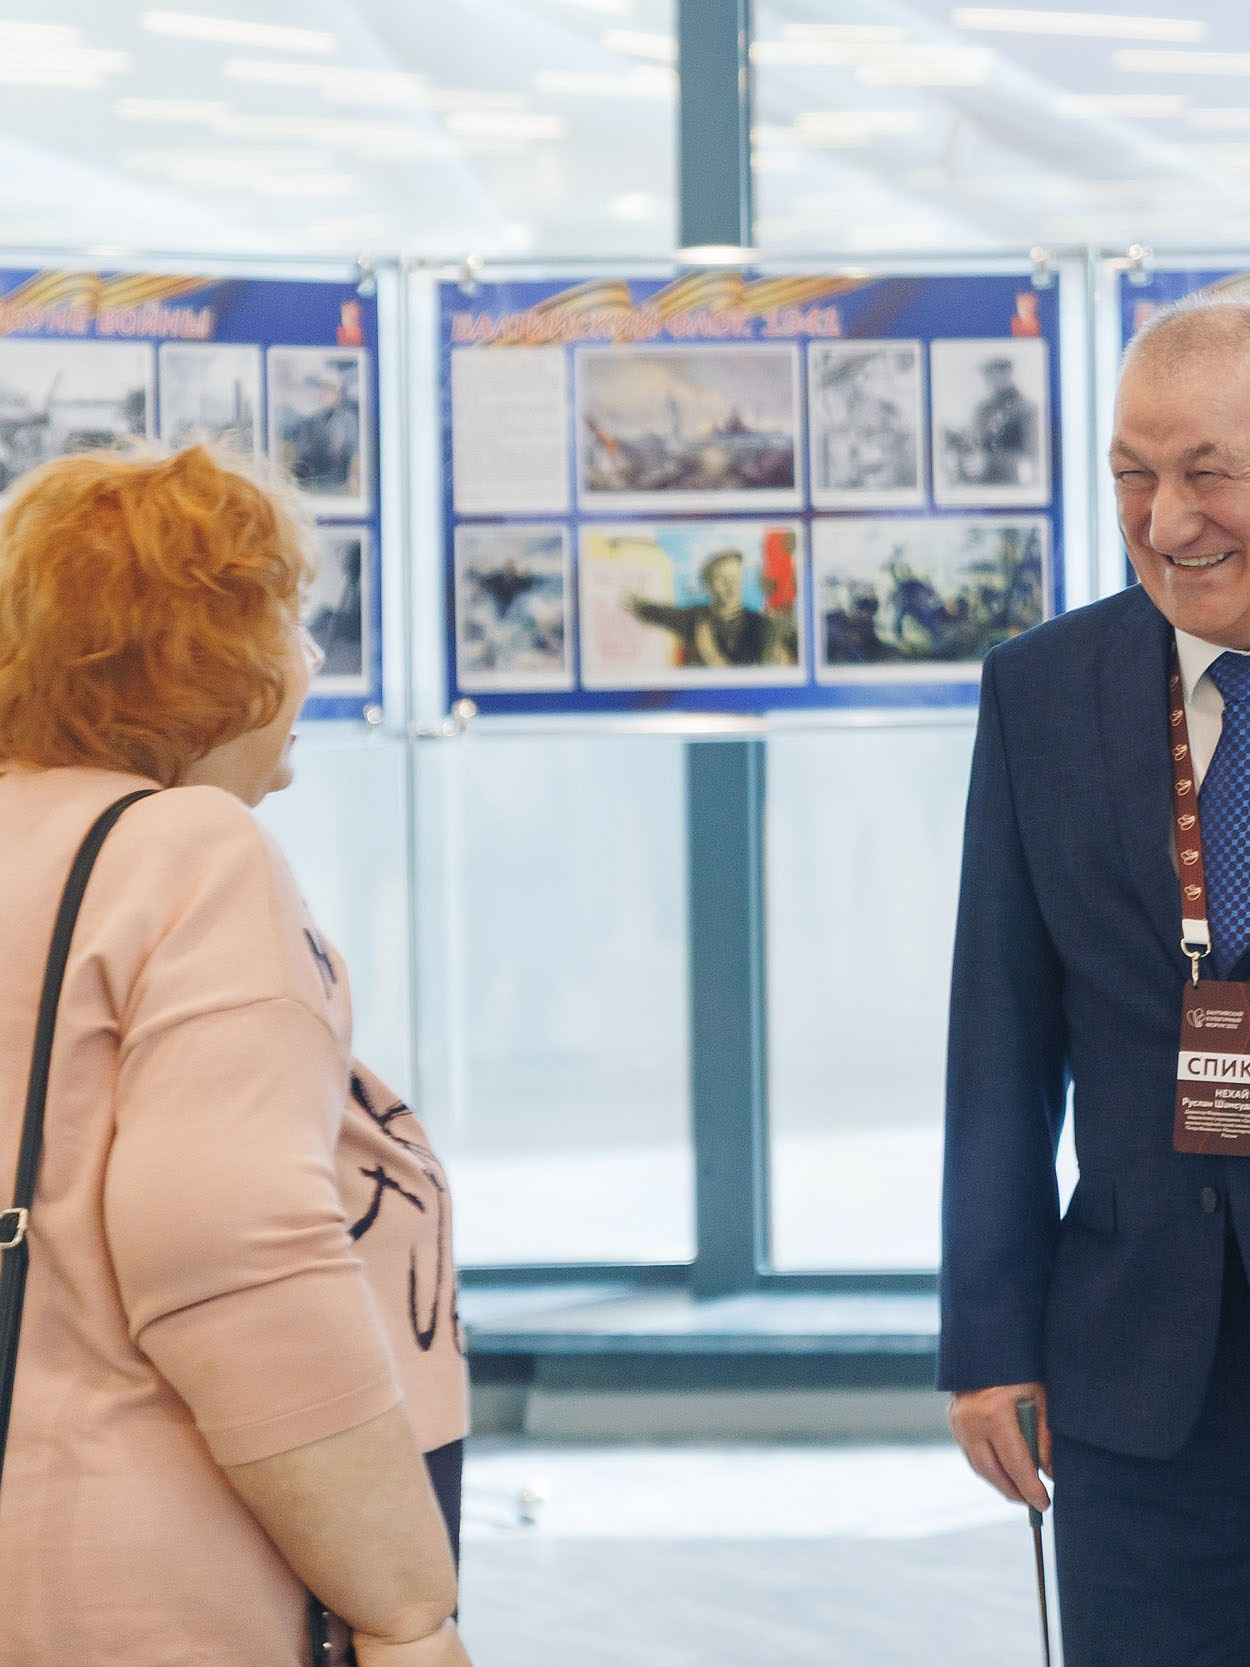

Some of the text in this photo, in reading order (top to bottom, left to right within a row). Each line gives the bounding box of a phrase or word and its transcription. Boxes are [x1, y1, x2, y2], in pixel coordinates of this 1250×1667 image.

[97, 301, 213, 338] ВОЙНЫ
[763, 305, 841, 338] 1941
[1215, 1088, 1250, 1099] НЕХАЙ
